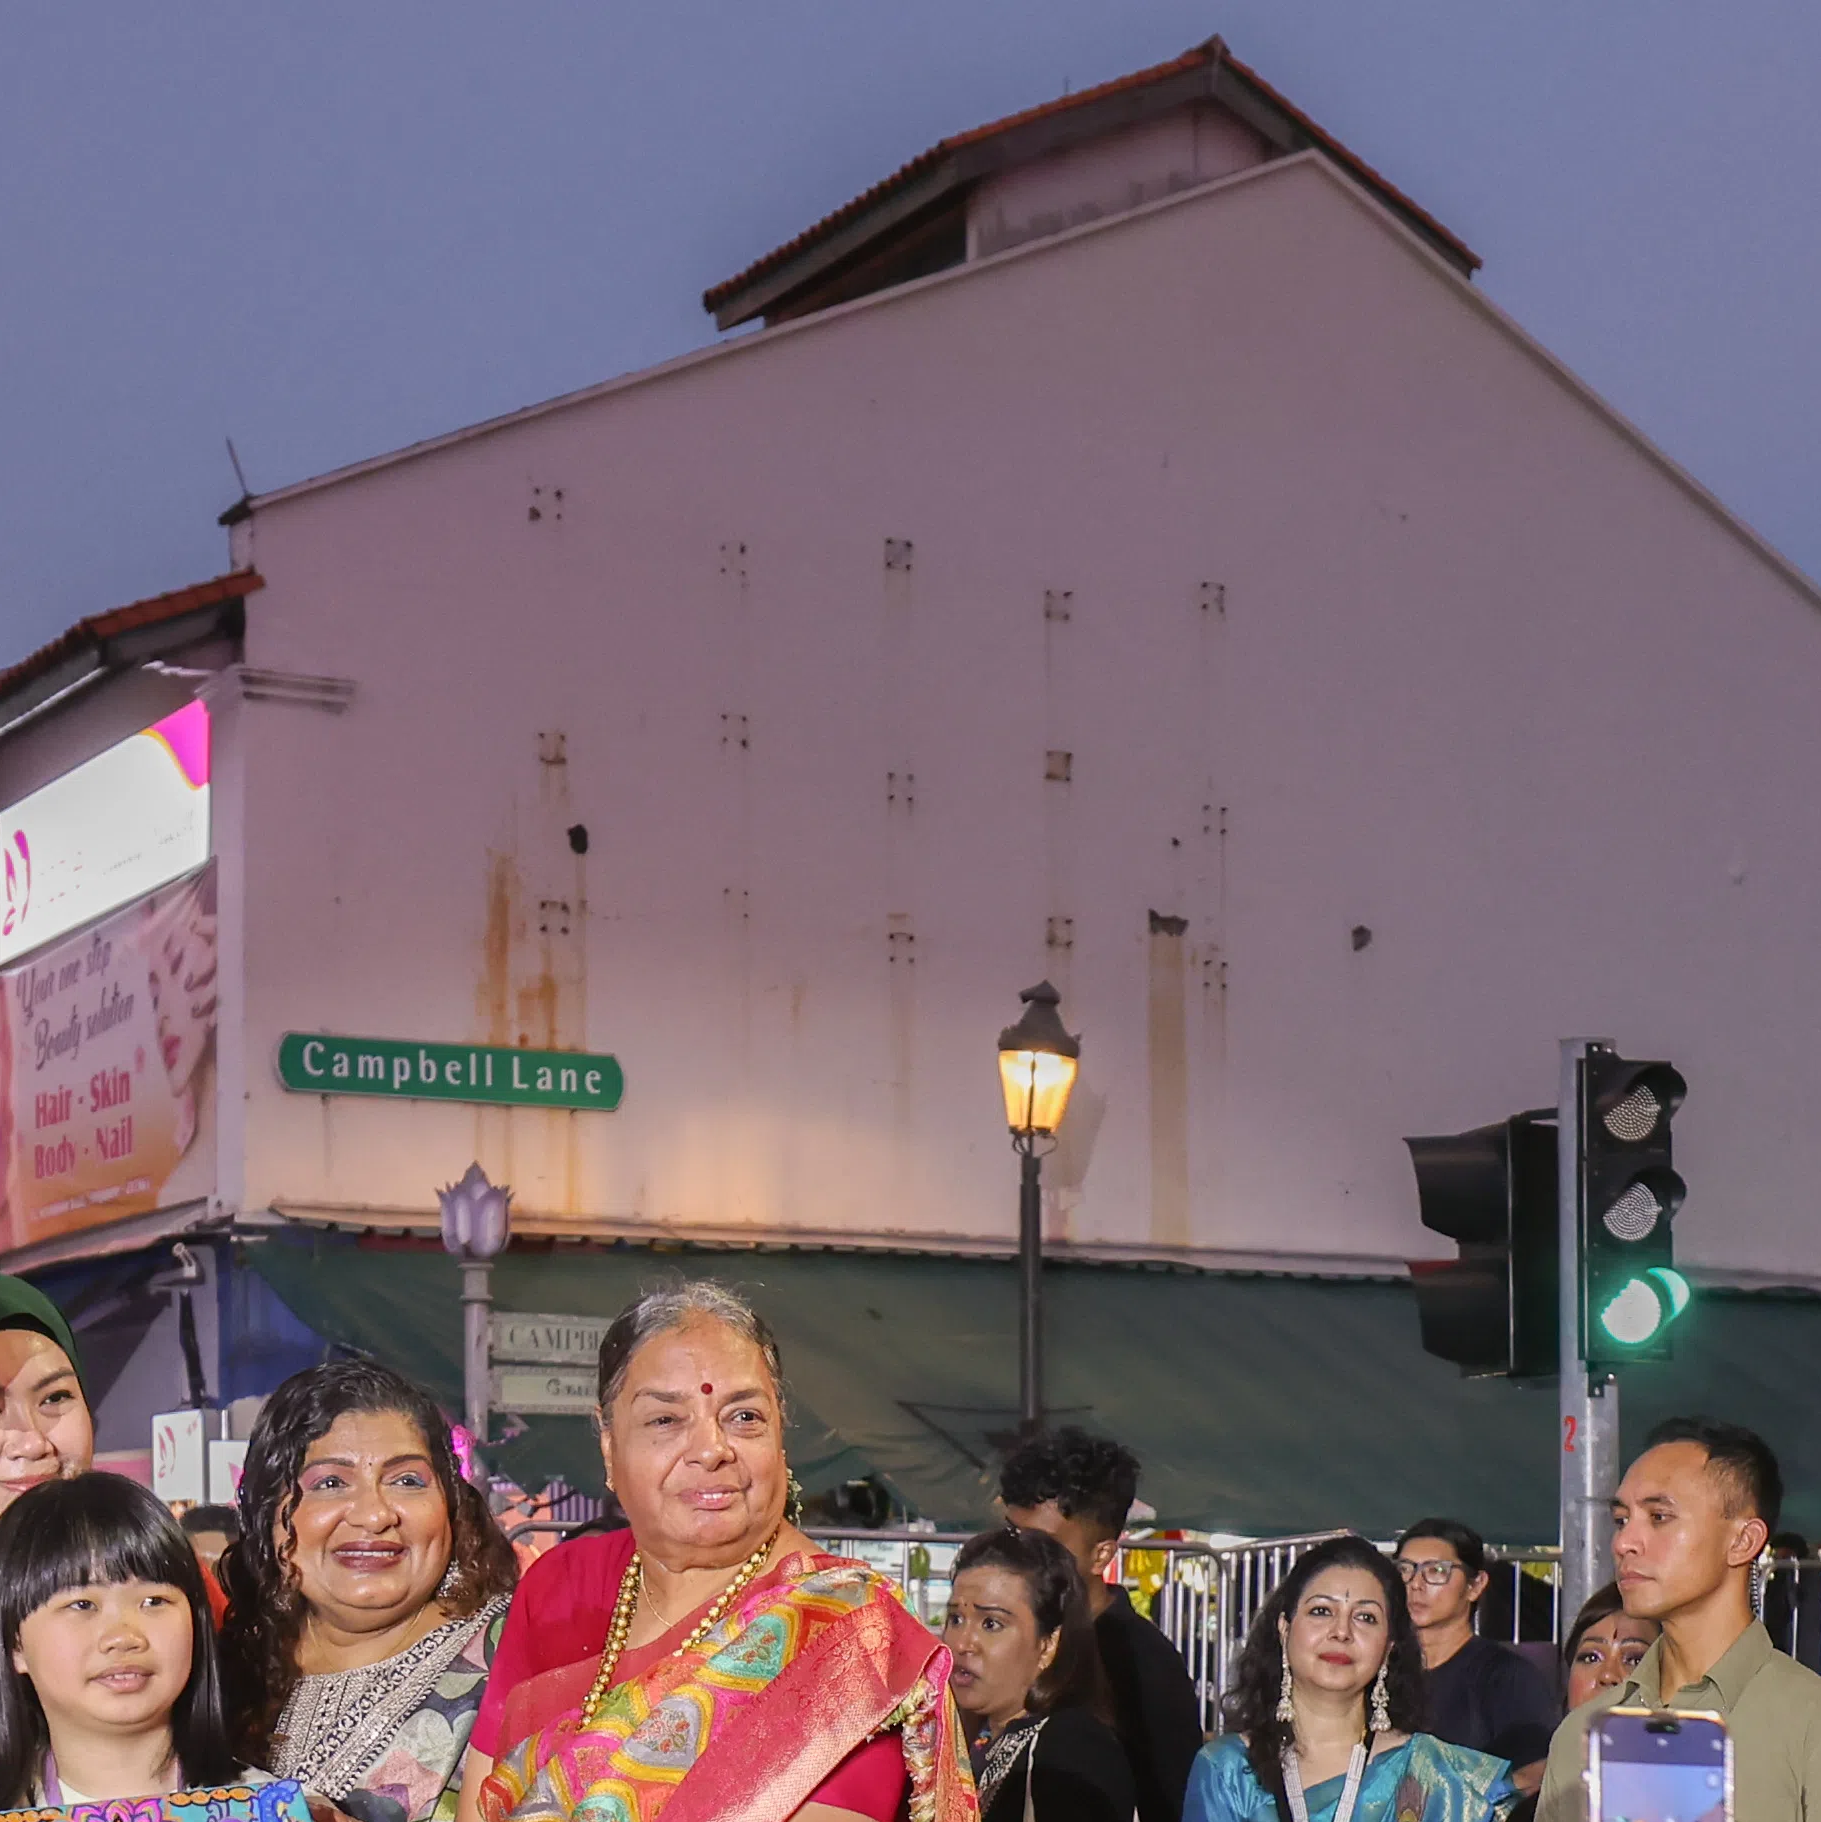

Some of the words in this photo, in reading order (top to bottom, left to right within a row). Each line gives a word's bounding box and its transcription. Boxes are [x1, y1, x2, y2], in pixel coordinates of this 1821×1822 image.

[34, 1003, 82, 1072] Beauty
[302, 1041, 494, 1089] Campbell
[512, 1055, 603, 1095] Lane
[35, 1085, 72, 1130] Hair
[89, 1066, 131, 1113] Skin
[34, 1134, 76, 1180] Body
[95, 1115, 132, 1161] Nail
[1563, 1415, 1577, 1453] 2
